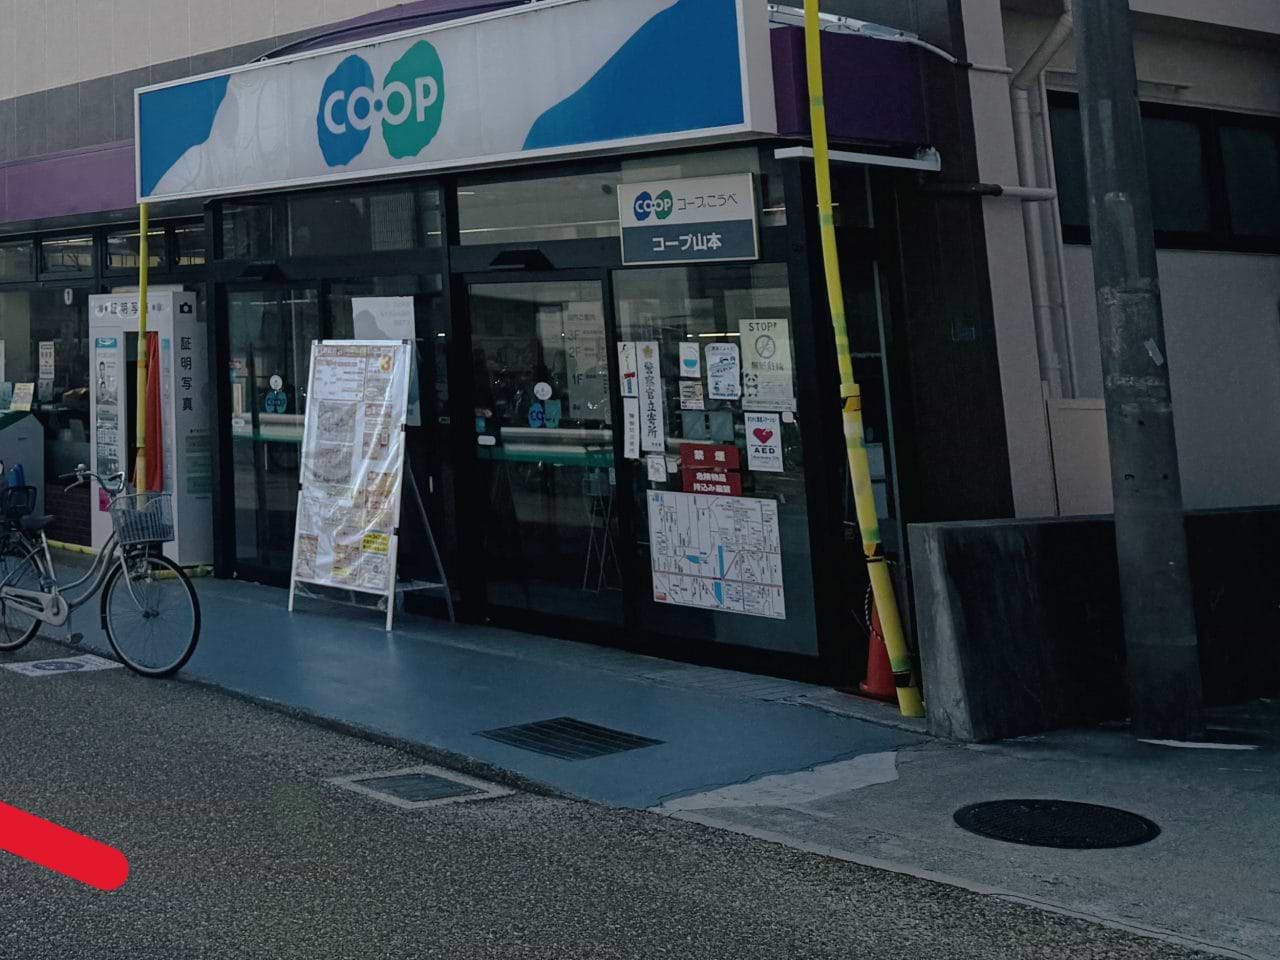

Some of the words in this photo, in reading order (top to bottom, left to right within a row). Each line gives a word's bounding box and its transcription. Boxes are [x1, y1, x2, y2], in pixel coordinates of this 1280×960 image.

[677, 193, 739, 211] コープこうべ
[652, 231, 723, 252] コープ山本
[180, 336, 194, 411] 証明写真
[572, 373, 583, 385] 1F
[643, 361, 658, 439] 警察官立寄所
